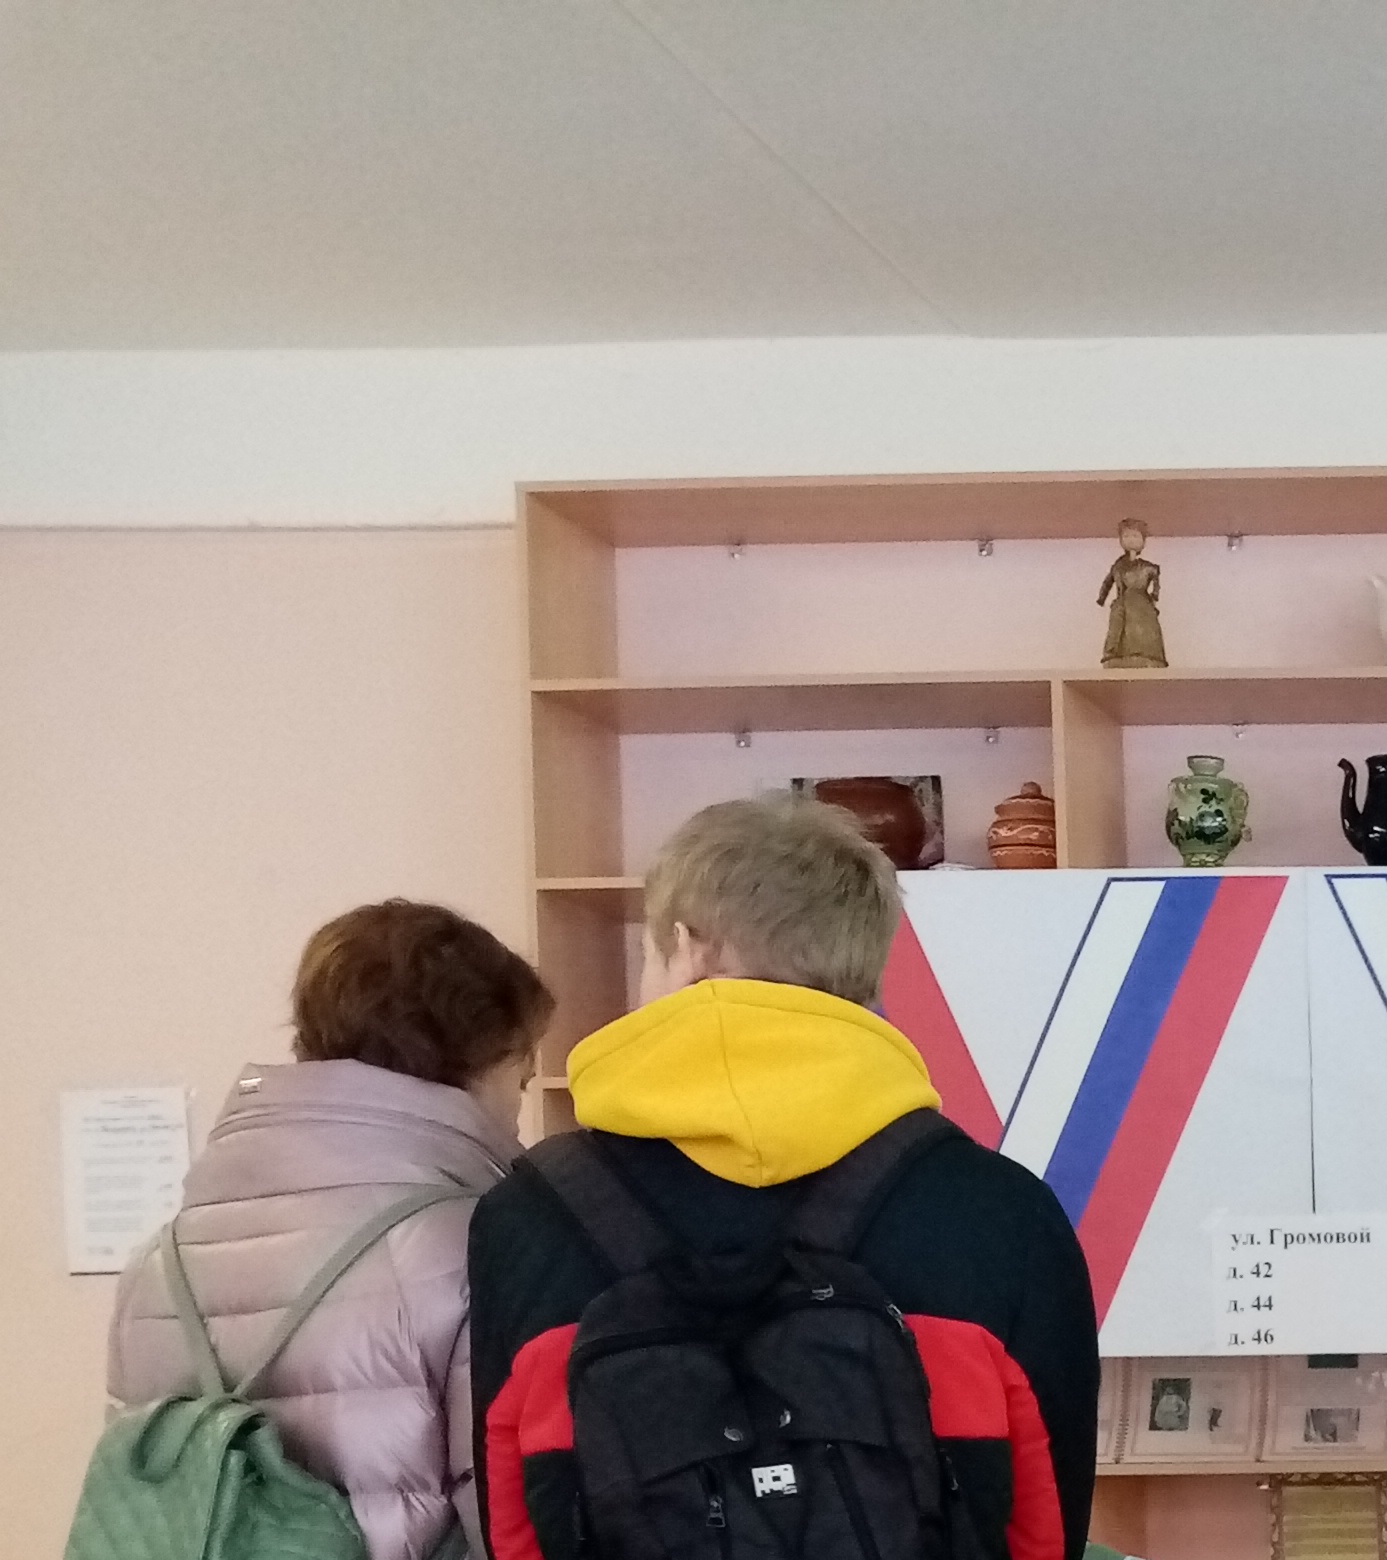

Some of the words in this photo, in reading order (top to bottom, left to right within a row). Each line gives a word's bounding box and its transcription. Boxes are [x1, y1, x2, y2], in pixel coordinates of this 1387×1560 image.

[1231, 1233, 1261, 1251] ул.
[1269, 1228, 1371, 1250] Громовой
[1226, 1266, 1244, 1280] д.
[1250, 1262, 1273, 1279] 42
[1226, 1300, 1245, 1313] д.
[1251, 1295, 1274, 1311] 44
[1227, 1333, 1245, 1346] д.
[1251, 1328, 1275, 1345] 46
